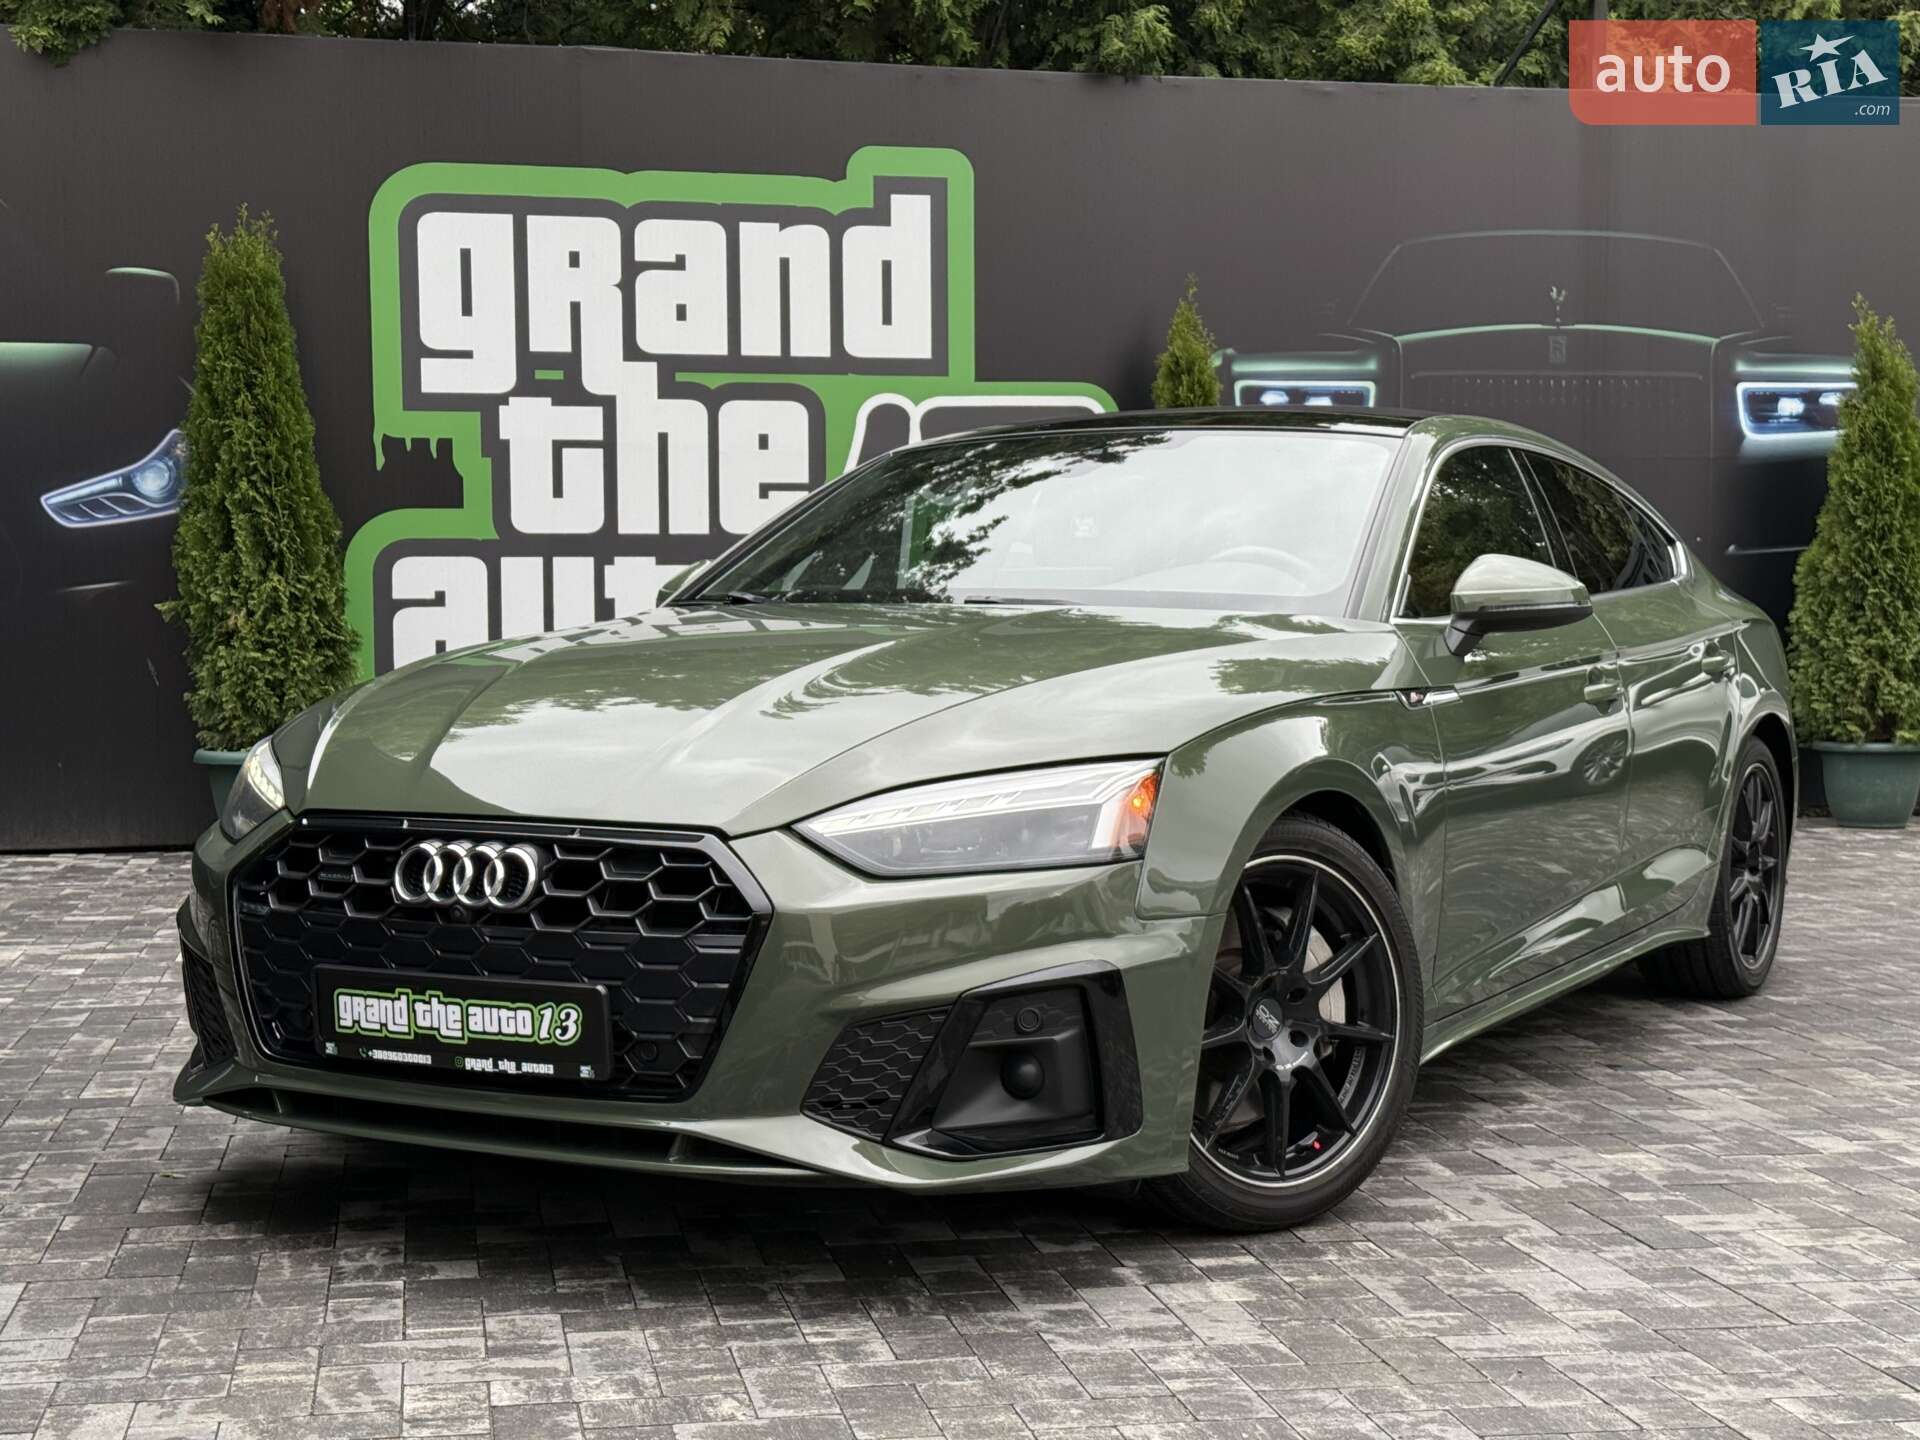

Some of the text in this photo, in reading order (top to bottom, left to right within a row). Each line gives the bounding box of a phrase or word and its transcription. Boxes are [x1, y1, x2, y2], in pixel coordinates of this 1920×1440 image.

[499, 361, 809, 535] the
[392, 556, 690, 670] au
[414, 997, 463, 1037] the
